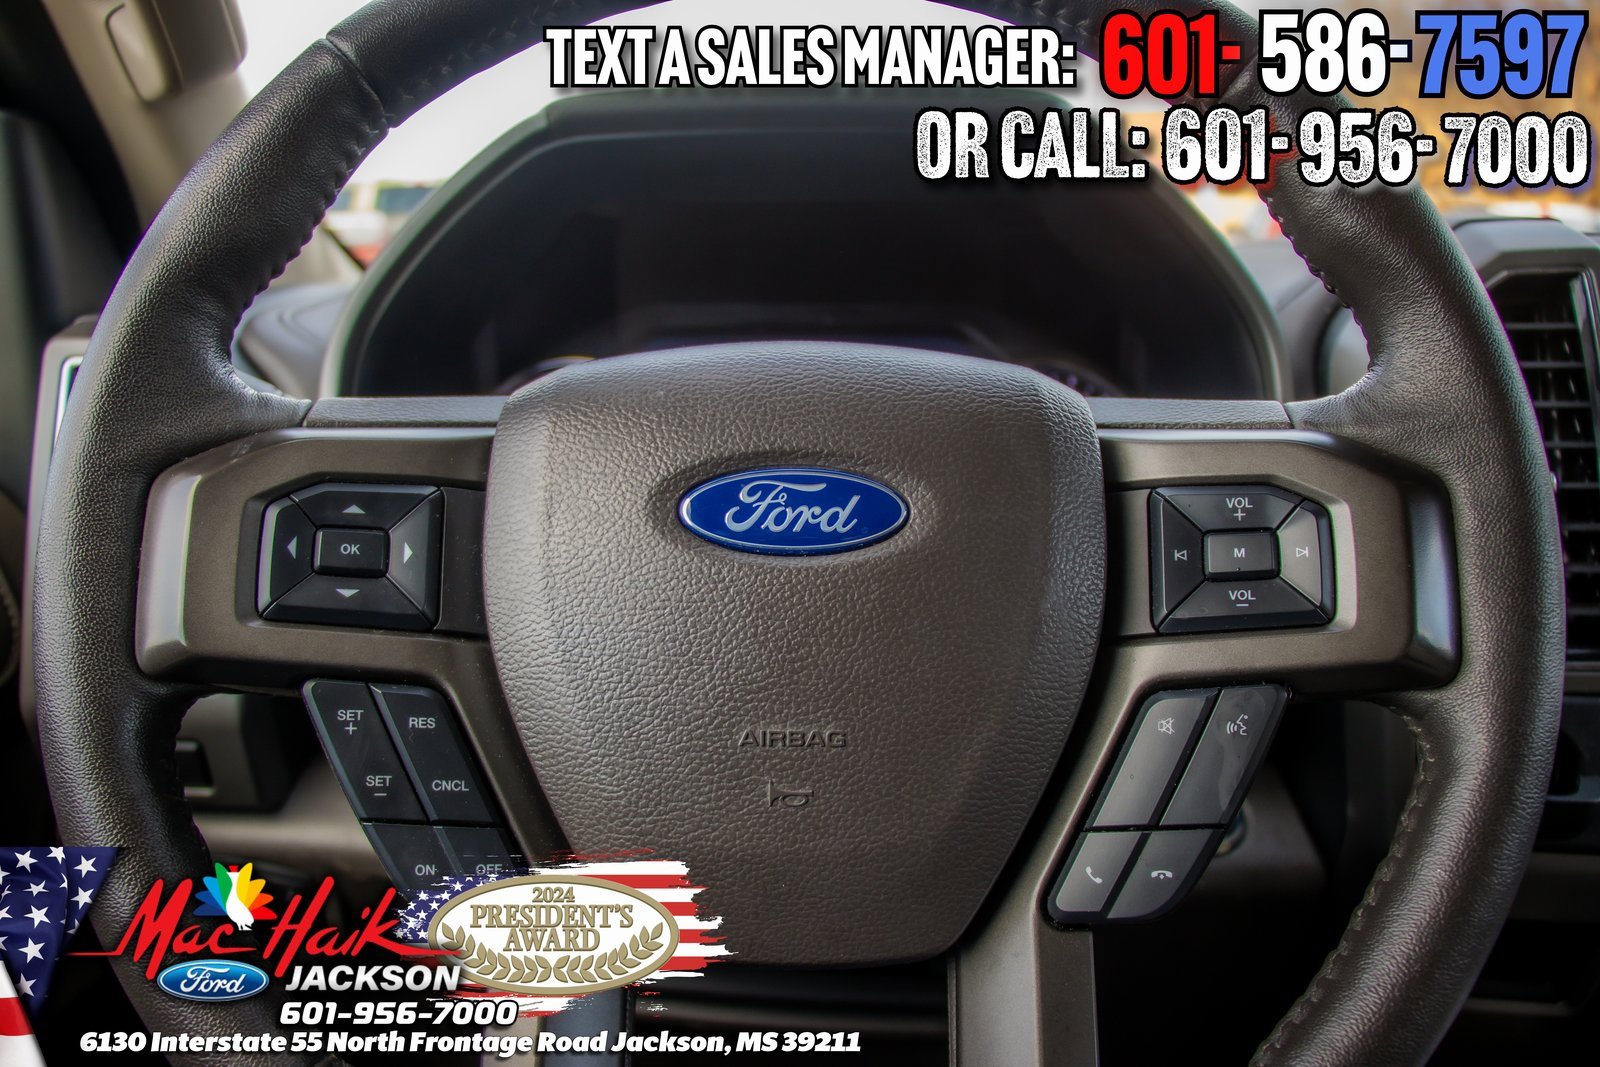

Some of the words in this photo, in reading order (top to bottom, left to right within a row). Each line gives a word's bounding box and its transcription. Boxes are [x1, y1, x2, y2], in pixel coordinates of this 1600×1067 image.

[725, 480, 860, 533] Ford
[1226, 497, 1253, 508] VOL
[340, 543, 361, 555] OK
[1234, 547, 1245, 558] M
[1228, 590, 1256, 600] VOL
[337, 709, 364, 721] SET
[408, 717, 436, 729] RES
[738, 730, 847, 748] AIRBAG
[365, 775, 392, 787] SET
[432, 780, 469, 792] CNCL
[415, 864, 436, 876] ON
[476, 864, 502, 876] OFF
